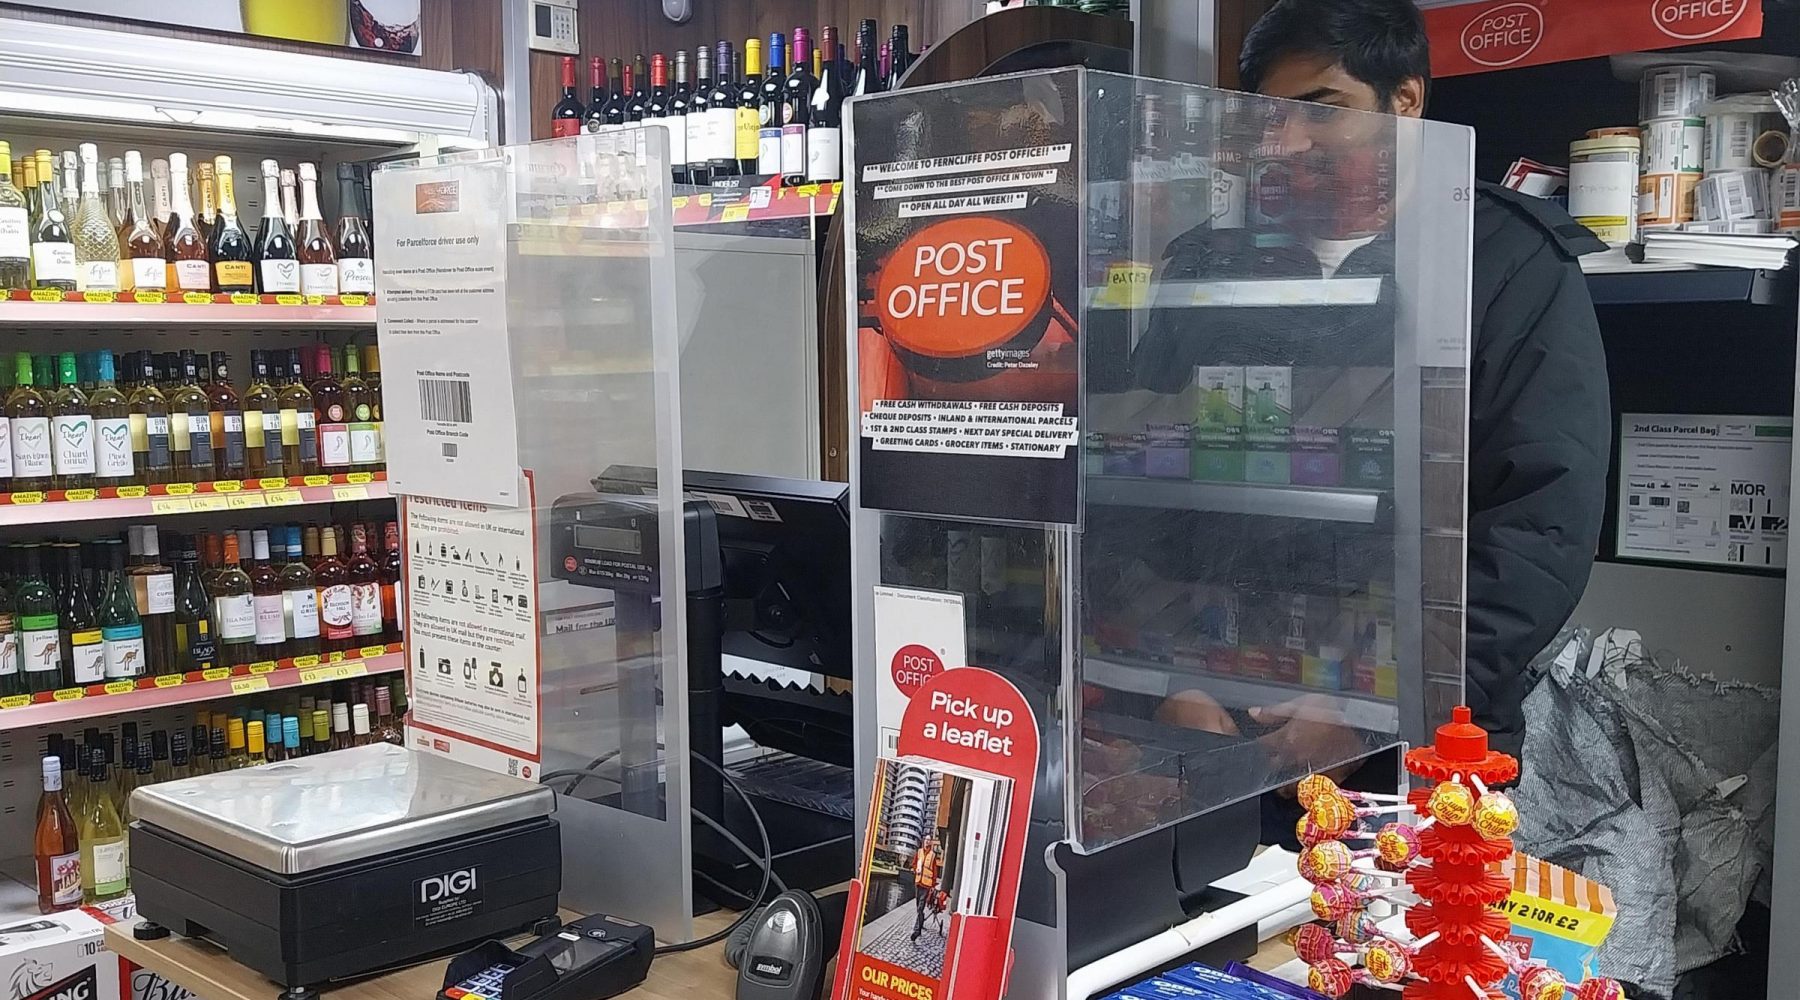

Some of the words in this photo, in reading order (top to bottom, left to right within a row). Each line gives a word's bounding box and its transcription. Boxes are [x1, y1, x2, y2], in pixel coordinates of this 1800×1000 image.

[1661, 0, 1734, 23] OFFICE
[1482, 13, 1527, 31] POST
[1469, 27, 1532, 51] OFFICE
[879, 162, 920, 173] WELCOME
[920, 160, 931, 169] TO
[933, 154, 982, 168] FERNCLIFFE
[984, 151, 1008, 161] POST
[1009, 147, 1049, 160] OFFICE!!
[904, 183, 925, 191] DOWN
[936, 180, 949, 188] THE
[967, 177, 984, 185] POST
[986, 173, 1010, 183] OFFICE
[1021, 171, 1044, 180] TOWN
[910, 201, 931, 211] OPEN
[932, 200, 947, 209] ALL
[948, 198, 966, 207] DAY
[966, 197, 981, 206] ALL
[983, 194, 1014, 205] WEEK!!
[396, 239, 406, 247] For
[407, 238, 437, 247] Parcelforce
[437, 236, 454, 246] driver
[455, 237, 466, 245] use
[467, 234, 479, 246] only
[914, 238, 1013, 277] POST
[887, 278, 1025, 319] OFFICE
[986, 348, 1030, 359] gettyimages
[917, 401, 973, 409] WITHDRAWALS
[999, 403, 1019, 411] CASH
[1021, 403, 1060, 412] DEPOSITS
[898, 413, 932, 421] DEPOSITS
[938, 414, 966, 422] INLAND
[975, 415, 1036, 425] INTERNATIONAL
[1038, 417, 1073, 426] PARCELS
[889, 425, 905, 433] 2ND
[906, 426, 928, 434] CLASS
[929, 426, 958, 435] STAMPS
[963, 428, 984, 436] NEXT
[984, 428, 1000, 437] DAY
[1001, 429, 1033, 438] SPECIAL
[1034, 430, 1074, 439] DELIVERY
[1634, 424, 1650, 433] 2nd
[1651, 425, 1672, 433] Class
[1673, 425, 1698, 434] Parcel
[1700, 426, 1716, 436] Bag
[880, 437, 914, 446] GREETING
[915, 438, 939, 447] CARDS
[945, 439, 980, 449] GROCERY
[981, 441, 1004, 450] ITEMS
[1010, 442, 1061, 452] STATIONARY
[1730, 483, 1766, 496] MOR
[556, 625, 574, 634] Mail
[903, 655, 934, 672] POST
[896, 669, 934, 688] OFFIC
[930, 690, 979, 719] Pick
[983, 705, 1014, 729] up
[923, 722, 938, 739] a
[941, 721, 1014, 756] leaflet
[421, 867, 477, 903] DIGI
[1488, 899, 1518, 913] ANY
[1517, 905, 1530, 917] 2
[1531, 907, 1555, 924] FOR
[1555, 915, 1580, 931] £2
[84, 941, 96, 955] 10
[861, 966, 889, 988] OUR
[890, 975, 933, 1000] PRICES
